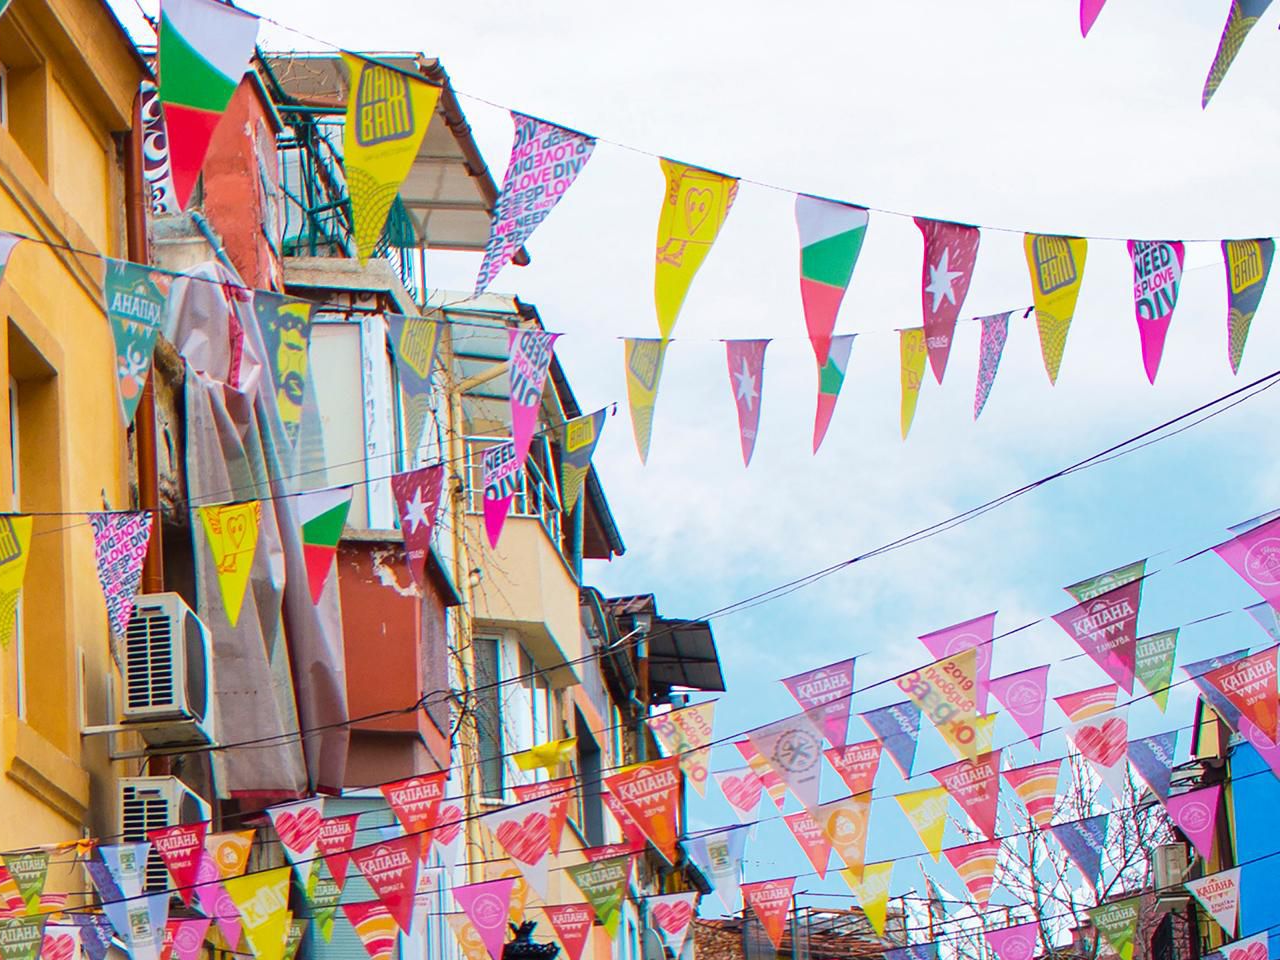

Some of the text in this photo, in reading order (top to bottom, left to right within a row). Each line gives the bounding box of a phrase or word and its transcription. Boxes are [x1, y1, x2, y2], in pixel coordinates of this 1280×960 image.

[1072, 602, 1133, 635] КАПАНА
[1221, 660, 1276, 691] КАПАНА
[391, 784, 441, 804] КАПАНА
[619, 771, 678, 798] КАПАНА
[156, 832, 200, 851] КАПАНА
[361, 850, 413, 874] КАПАНА
[1196, 879, 1234, 897] КАПАНА
